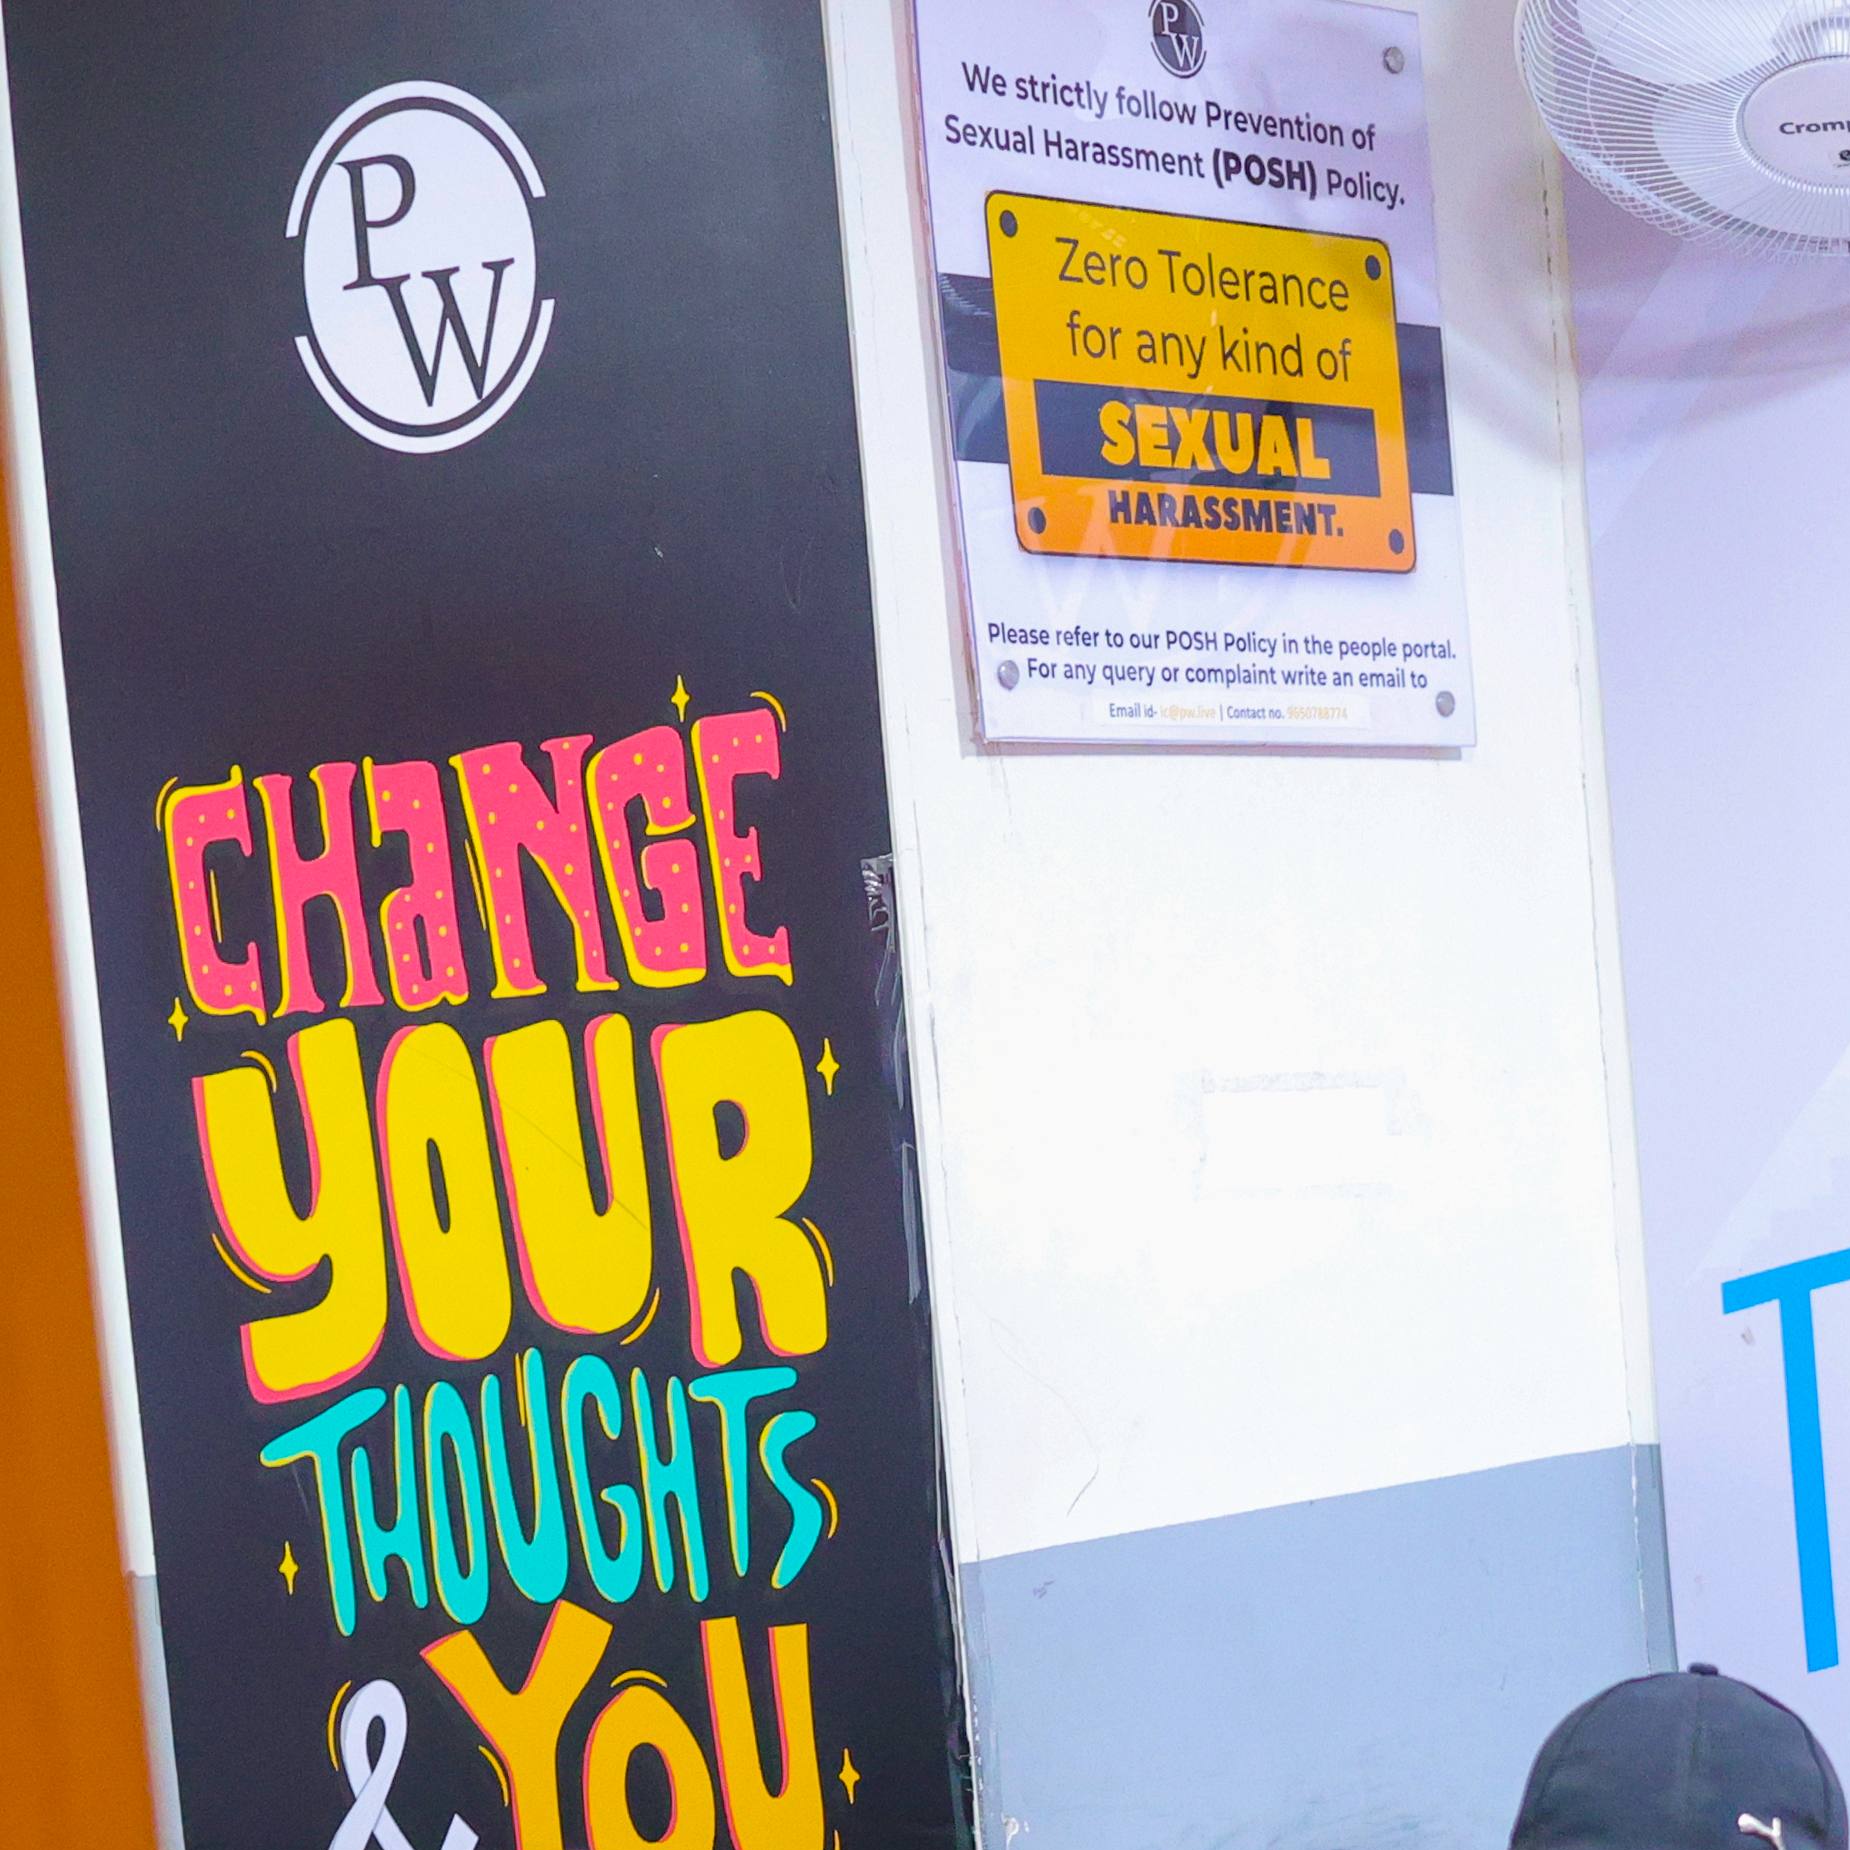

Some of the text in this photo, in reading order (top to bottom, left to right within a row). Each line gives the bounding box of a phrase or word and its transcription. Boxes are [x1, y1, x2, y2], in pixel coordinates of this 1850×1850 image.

[961, 61, 1376, 151] We strictly follow Prevention of
[944, 114, 1406, 210] Sexual Harassment (POSH) Policy.
[1055, 236, 1350, 312] Zero Tolerance
[1066, 310, 1352, 382] for any kind of
[1099, 400, 1332, 480] SEXUAL
[1108, 489, 1344, 537] HARASSMENT.
[988, 622, 1457, 662] Please refer to our POSH Policy in the people portal.
[1027, 657, 1428, 689] For any query or complaint write an email to
[1108, 702, 1141, 719] Email
[1226, 705, 1266, 720] Contact
[1268, 706, 1285, 720] no.
[191, 1009, 829, 1404] YOUR
[260, 1347, 823, 1637] THOUGHTS
